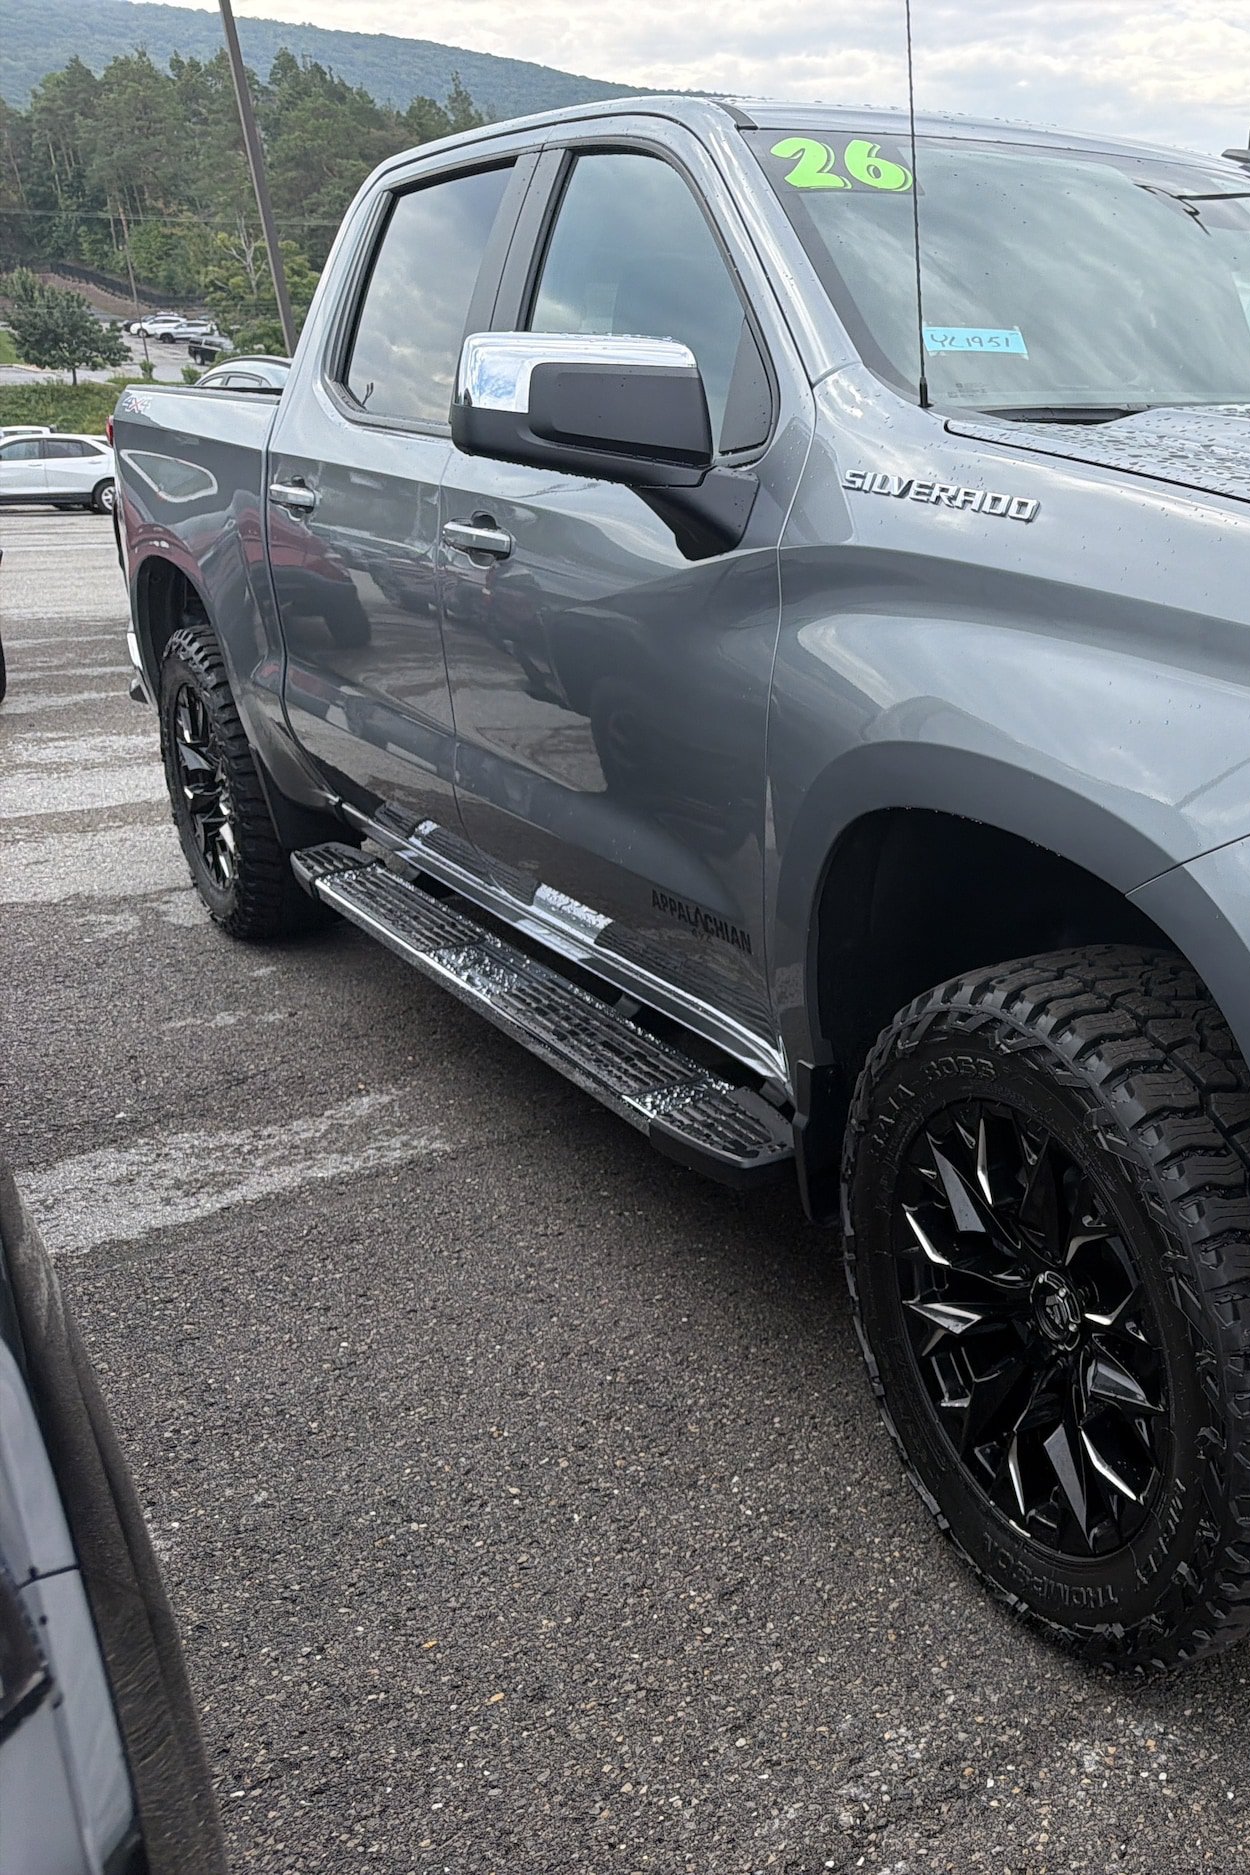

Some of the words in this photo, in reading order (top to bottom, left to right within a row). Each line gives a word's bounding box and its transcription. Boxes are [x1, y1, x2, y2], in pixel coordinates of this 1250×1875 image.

[770, 136, 913, 191] 26
[842, 468, 1041, 523] SILVERADO
[652, 889, 754, 956] APPALACHIAN
